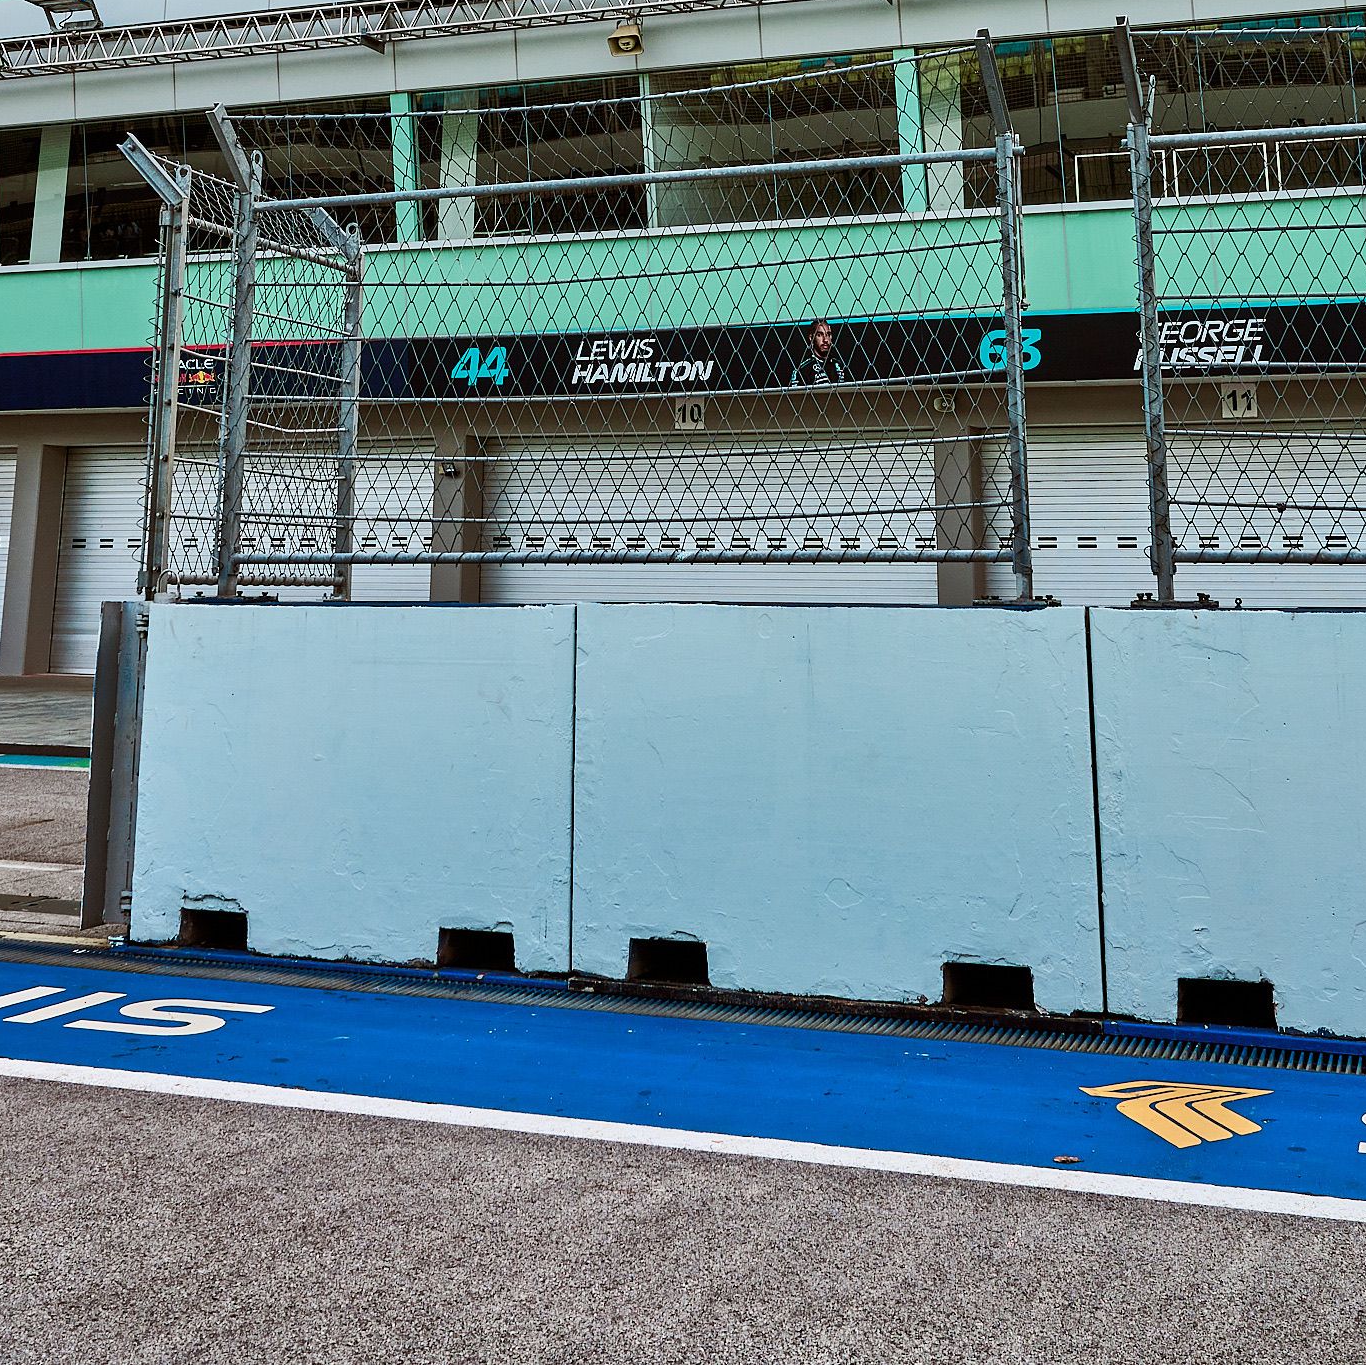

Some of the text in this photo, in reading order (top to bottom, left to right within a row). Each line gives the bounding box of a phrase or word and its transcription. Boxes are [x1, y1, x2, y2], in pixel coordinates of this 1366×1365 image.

[1138, 318, 1266, 345] EORGE
[576, 339, 655, 361] LEWIS
[451, 346, 510, 386] 44
[571, 361, 714, 385] HAMILTON
[1226, 389, 1252, 412] 11
[677, 402, 702, 424] 10
